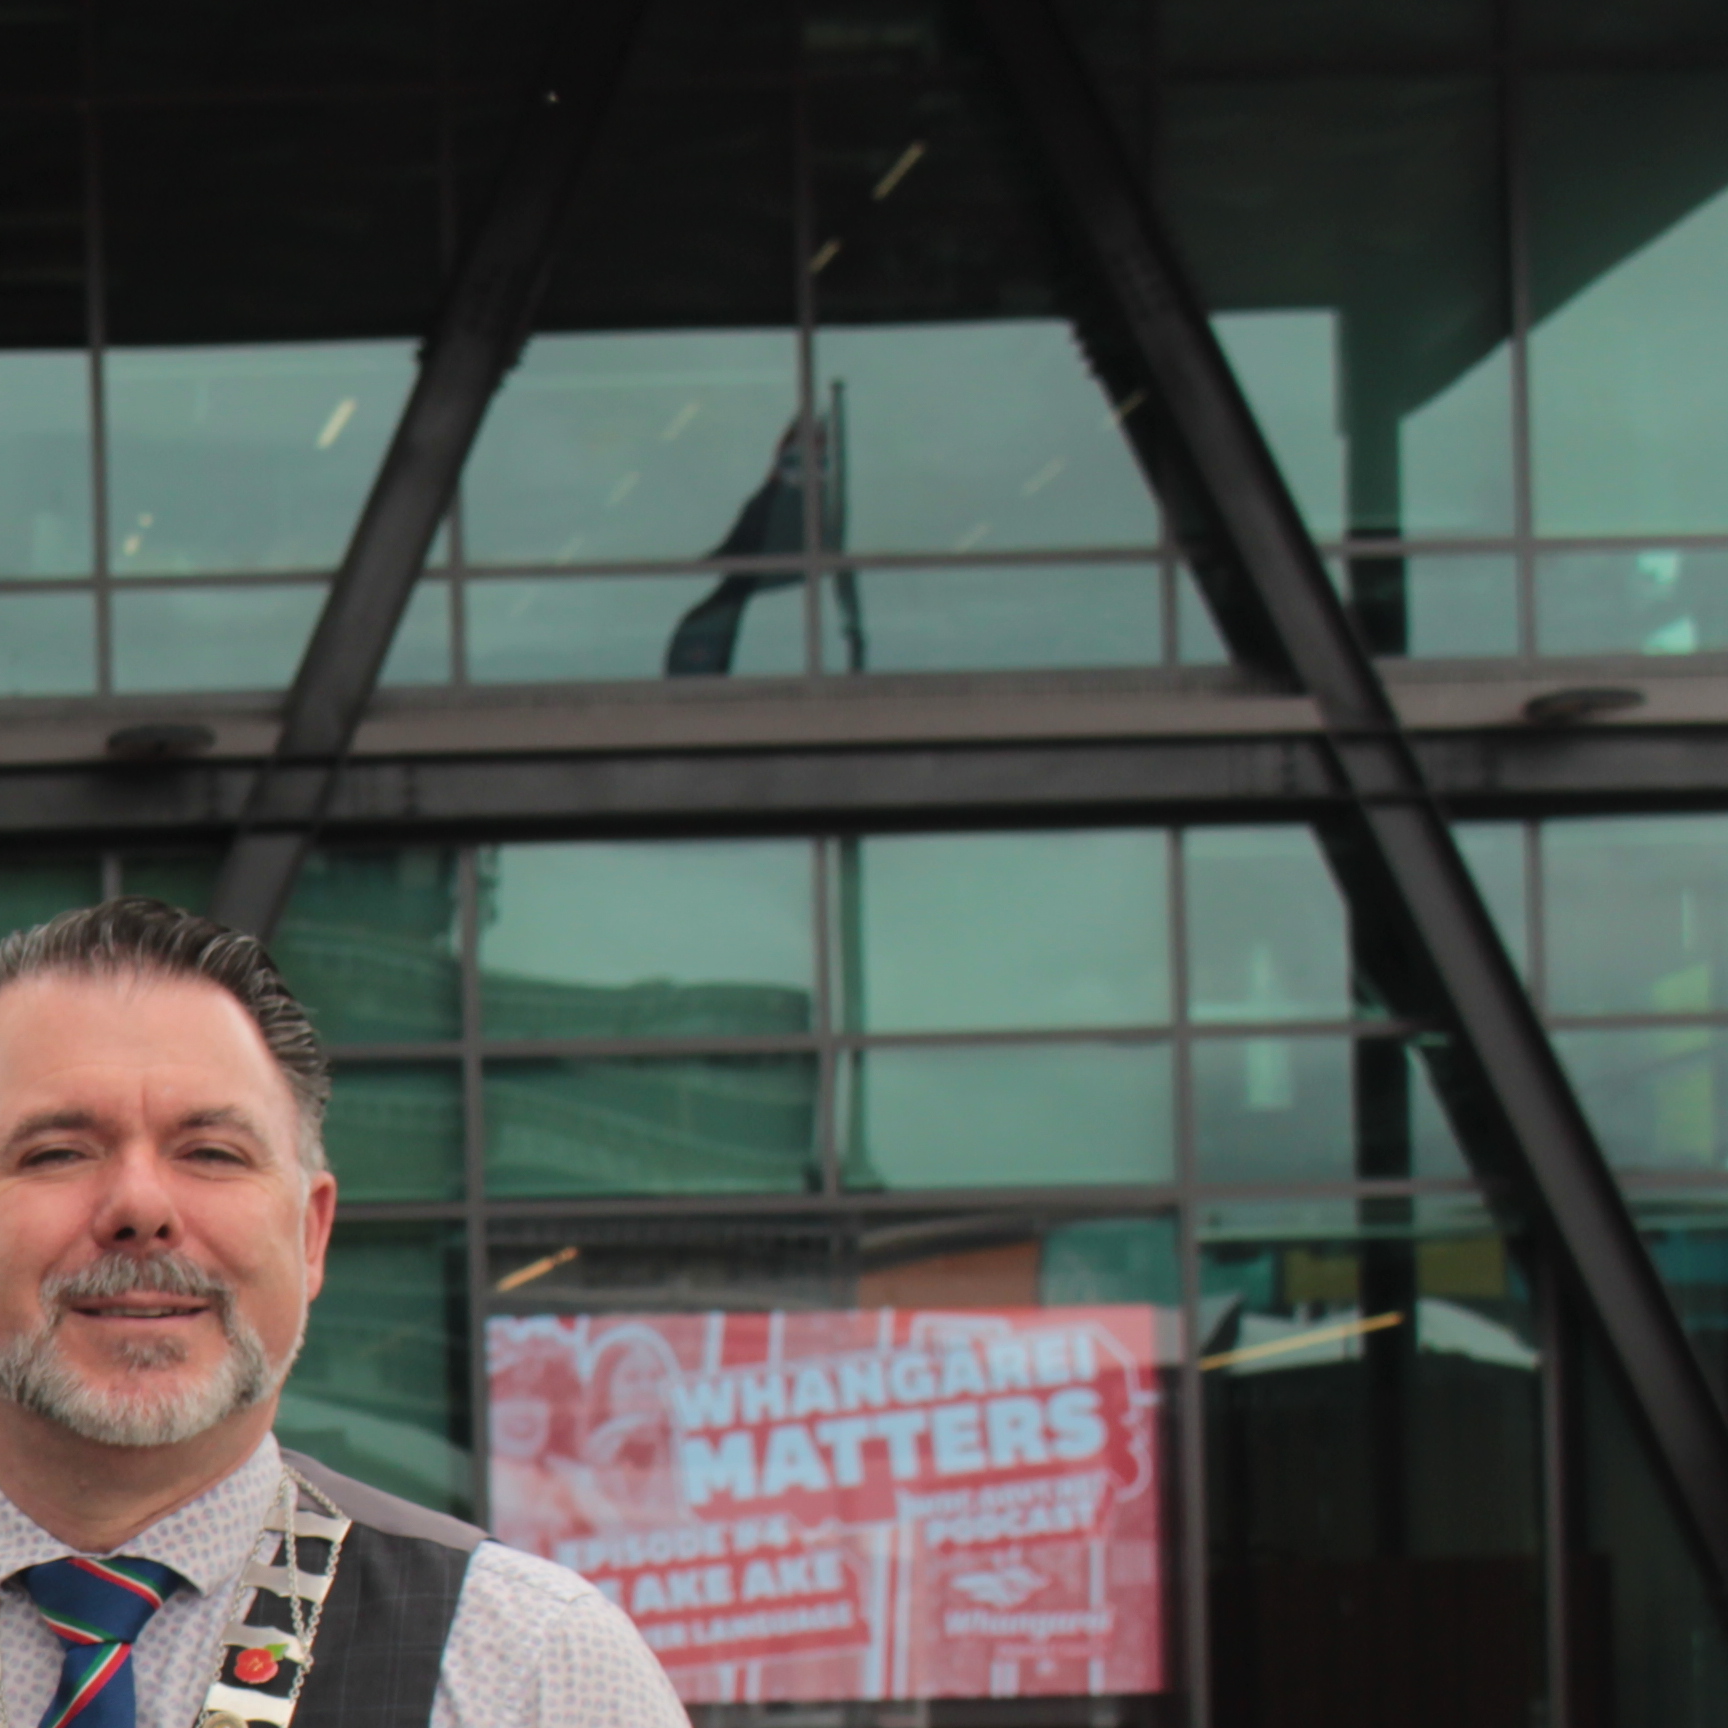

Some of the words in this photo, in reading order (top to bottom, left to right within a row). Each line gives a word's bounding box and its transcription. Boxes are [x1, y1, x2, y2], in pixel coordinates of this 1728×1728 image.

[684, 1388, 1109, 1505] MATTERS
[556, 1522, 723, 1574] EPISODE
[631, 1563, 734, 1615] AKE
[743, 1551, 843, 1601] AKE
